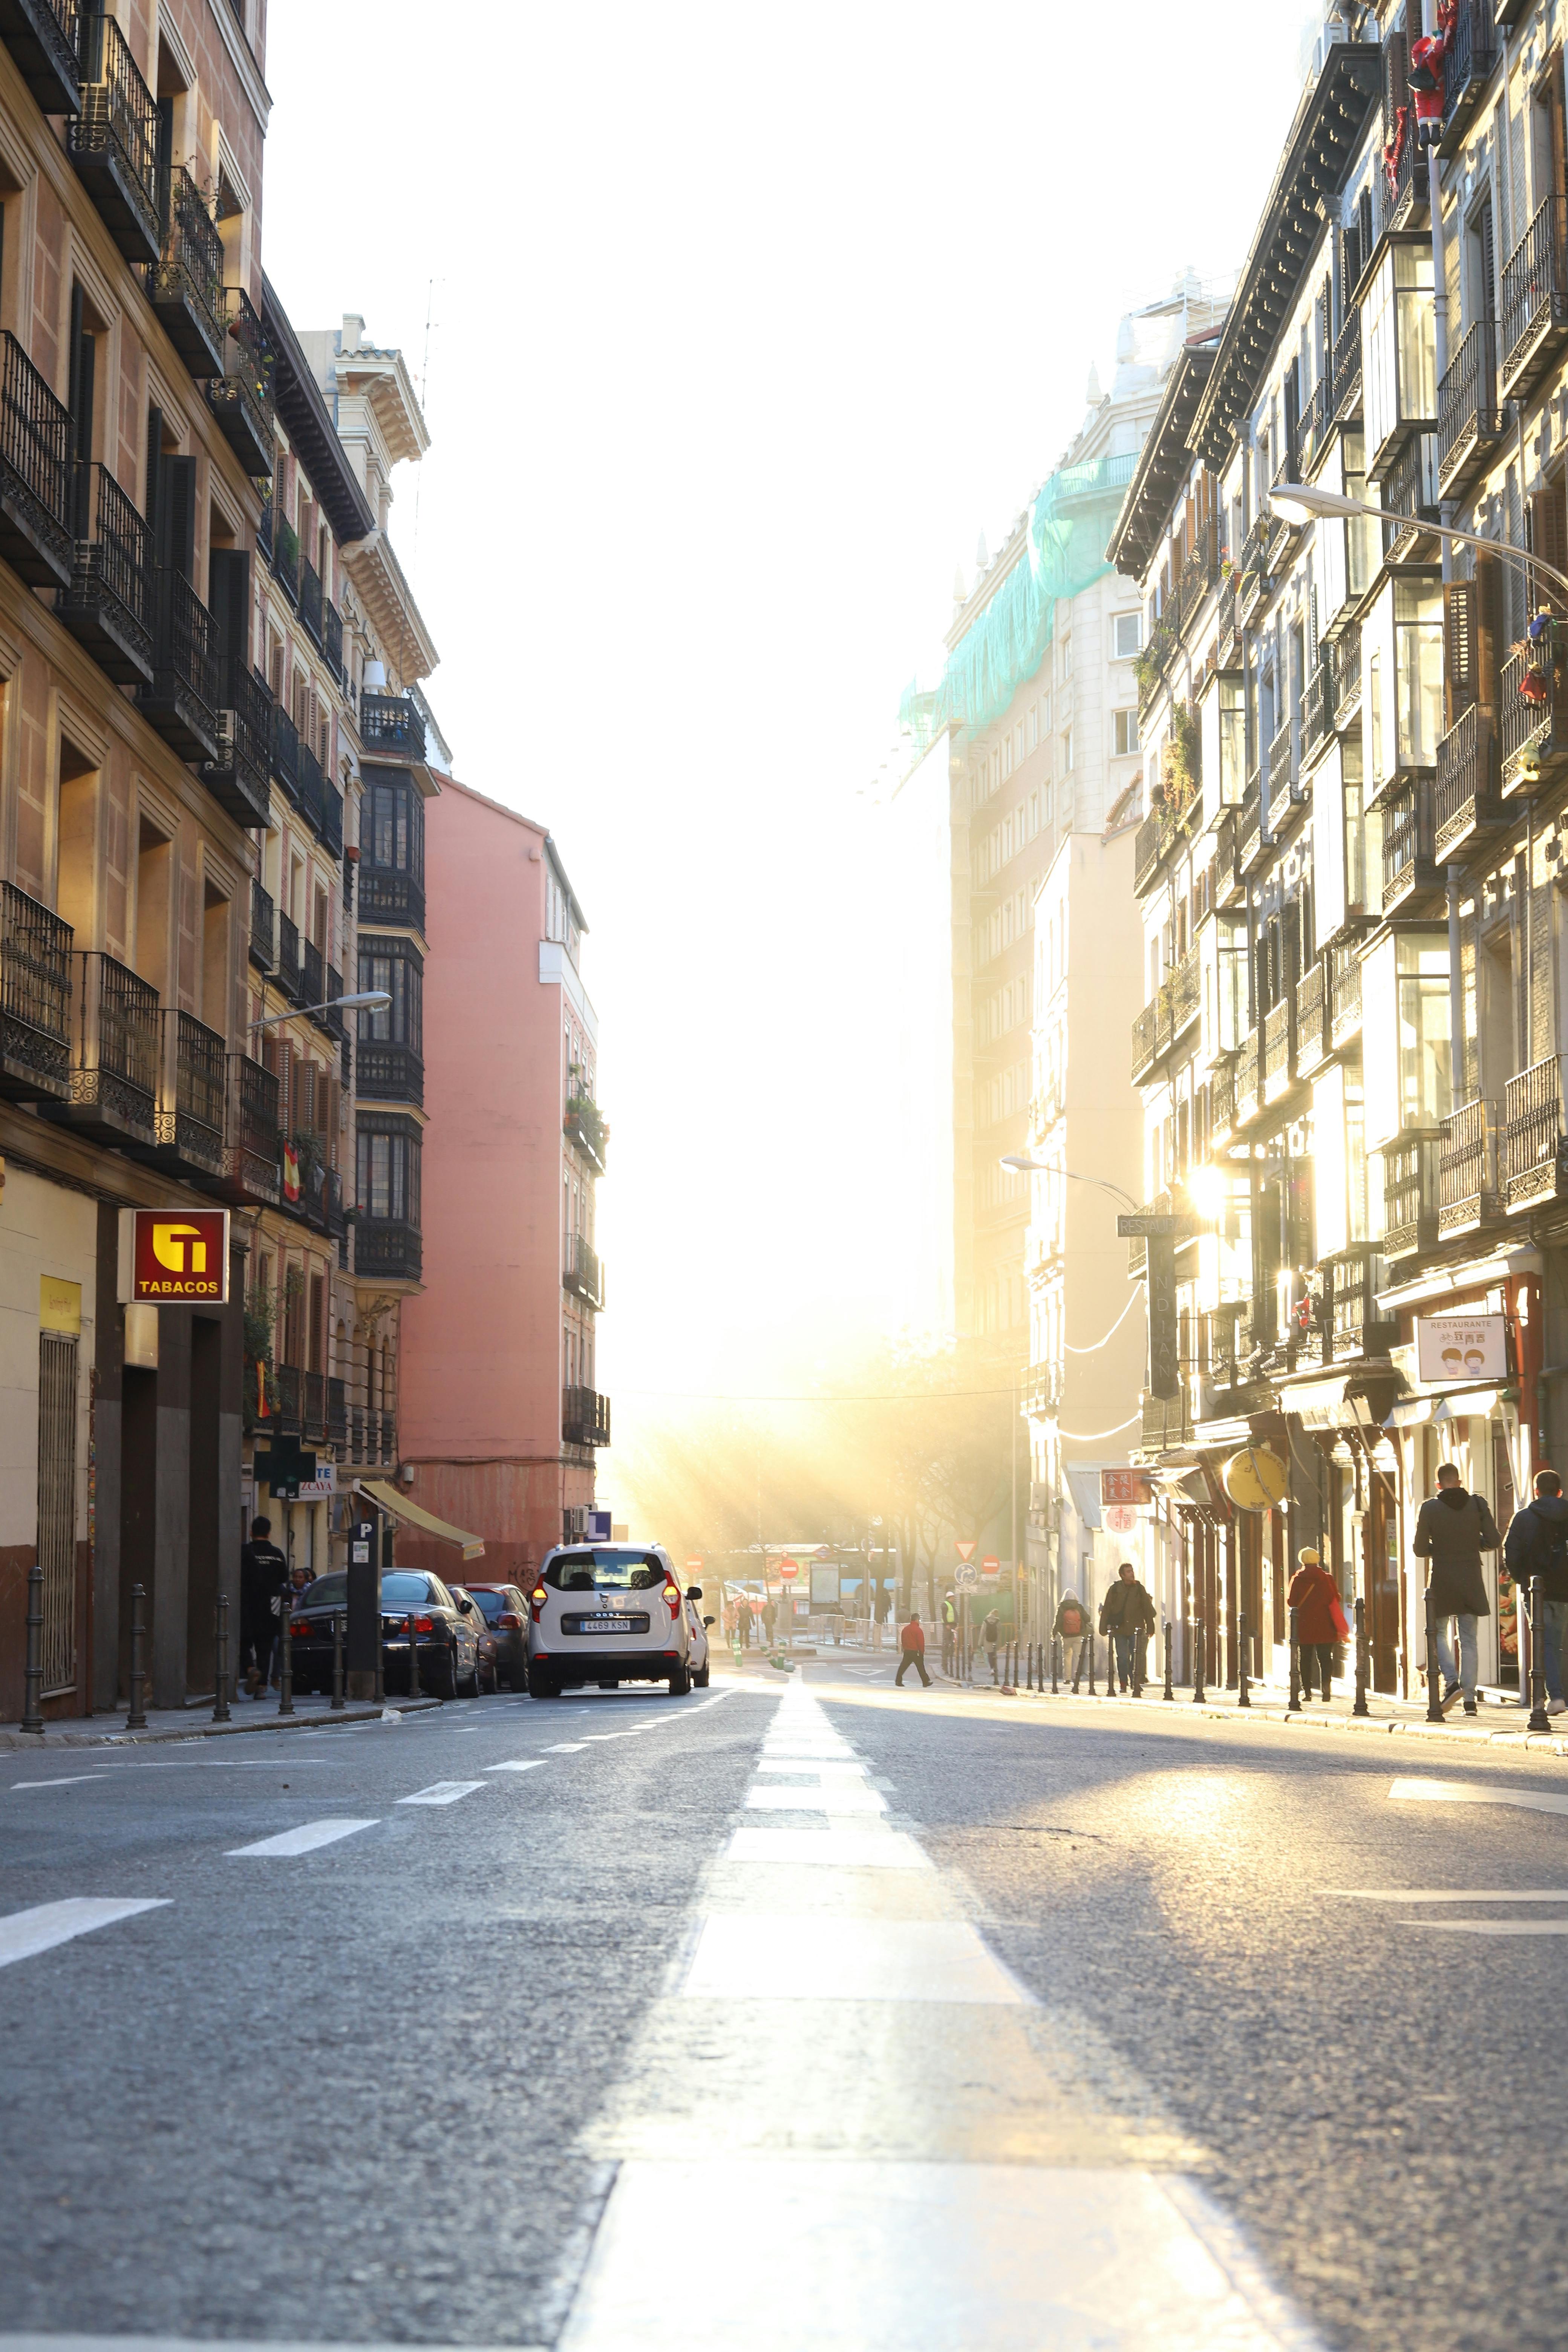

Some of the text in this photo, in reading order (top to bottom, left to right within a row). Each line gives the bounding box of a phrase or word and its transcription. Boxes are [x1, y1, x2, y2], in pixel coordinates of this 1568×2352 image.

[1120, 1217, 1199, 1234] RESTAURAN
[139, 1281, 218, 1293] TABACOS
[1431, 1320, 1492, 1329] RESTAURANTE
[301, 1481, 332, 1490] ZCAYA
[360, 1523, 373, 1538] P
[611, 1621, 628, 1629] KSN
